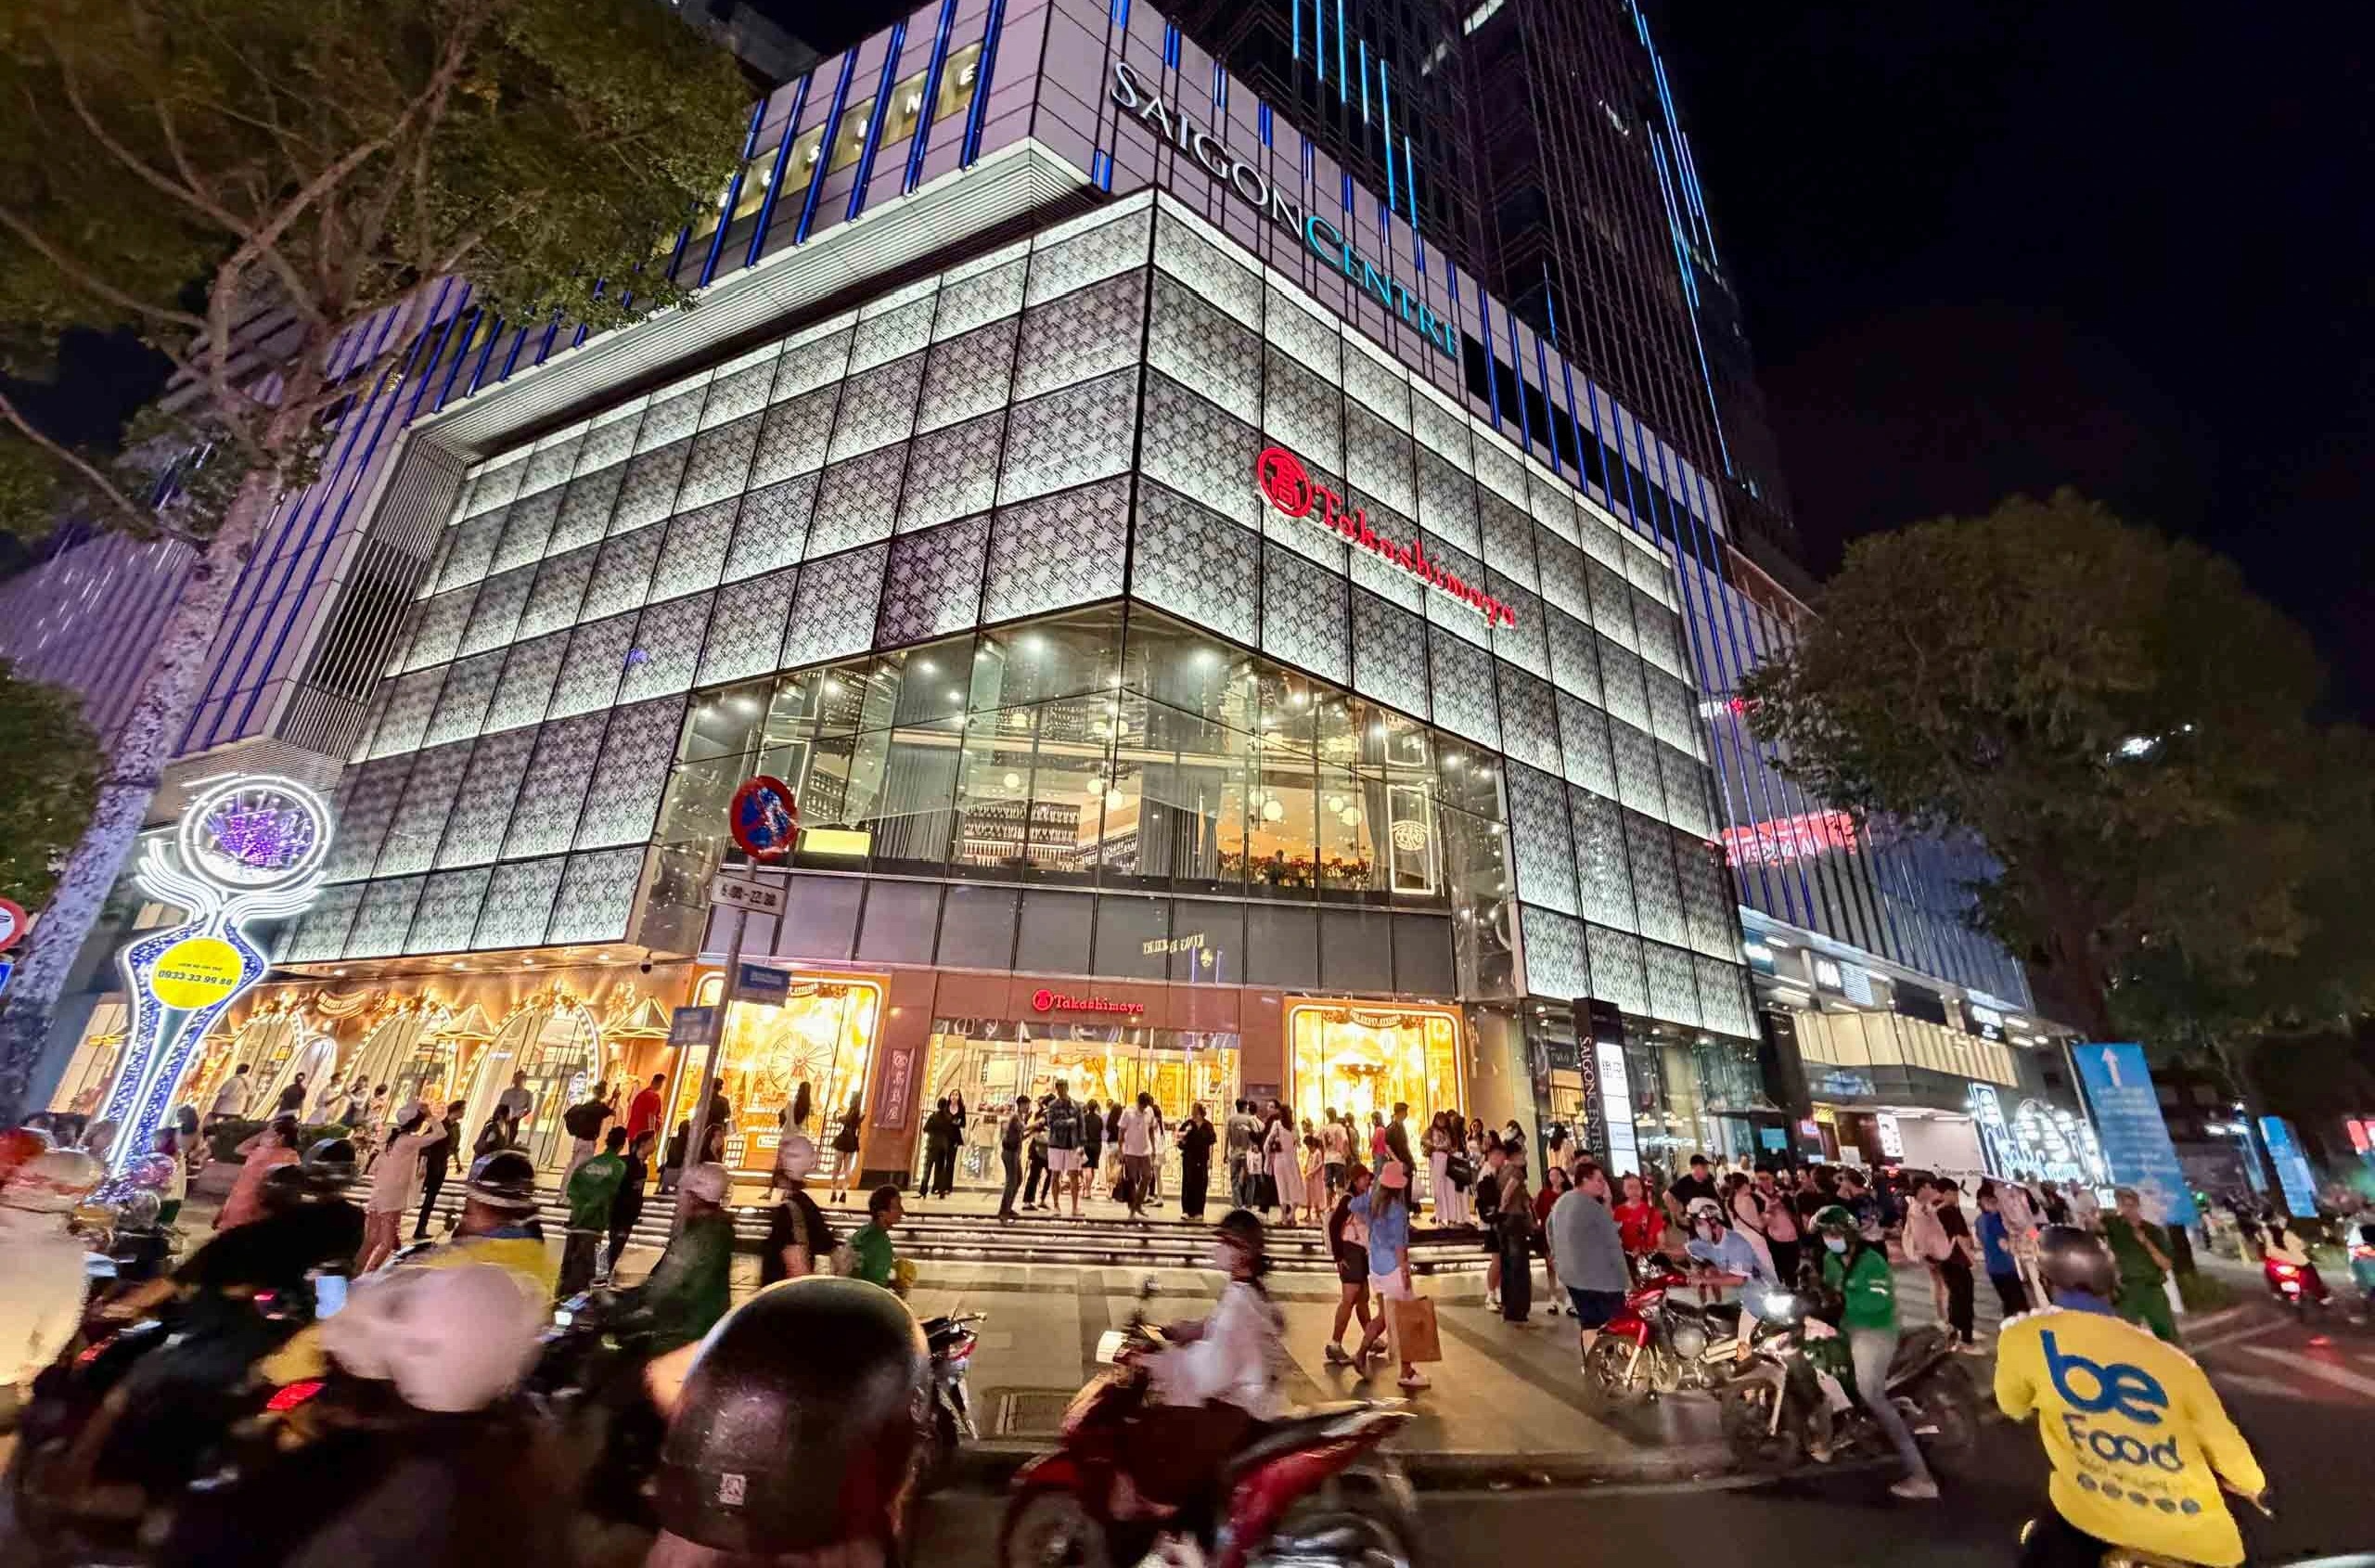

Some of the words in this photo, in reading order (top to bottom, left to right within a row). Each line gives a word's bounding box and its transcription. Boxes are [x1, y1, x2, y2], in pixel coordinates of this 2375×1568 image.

[1110, 61, 1303, 240] SAIGON
[1305, 214, 1459, 358] CENTRE
[1315, 483, 1516, 629] Takashimaya
[1053, 994, 1144, 1015] Takashimaya
[1579, 1035, 1597, 1096] SAIGON
[2039, 1330, 2169, 1425] be
[2061, 1412, 2184, 1473] Food
